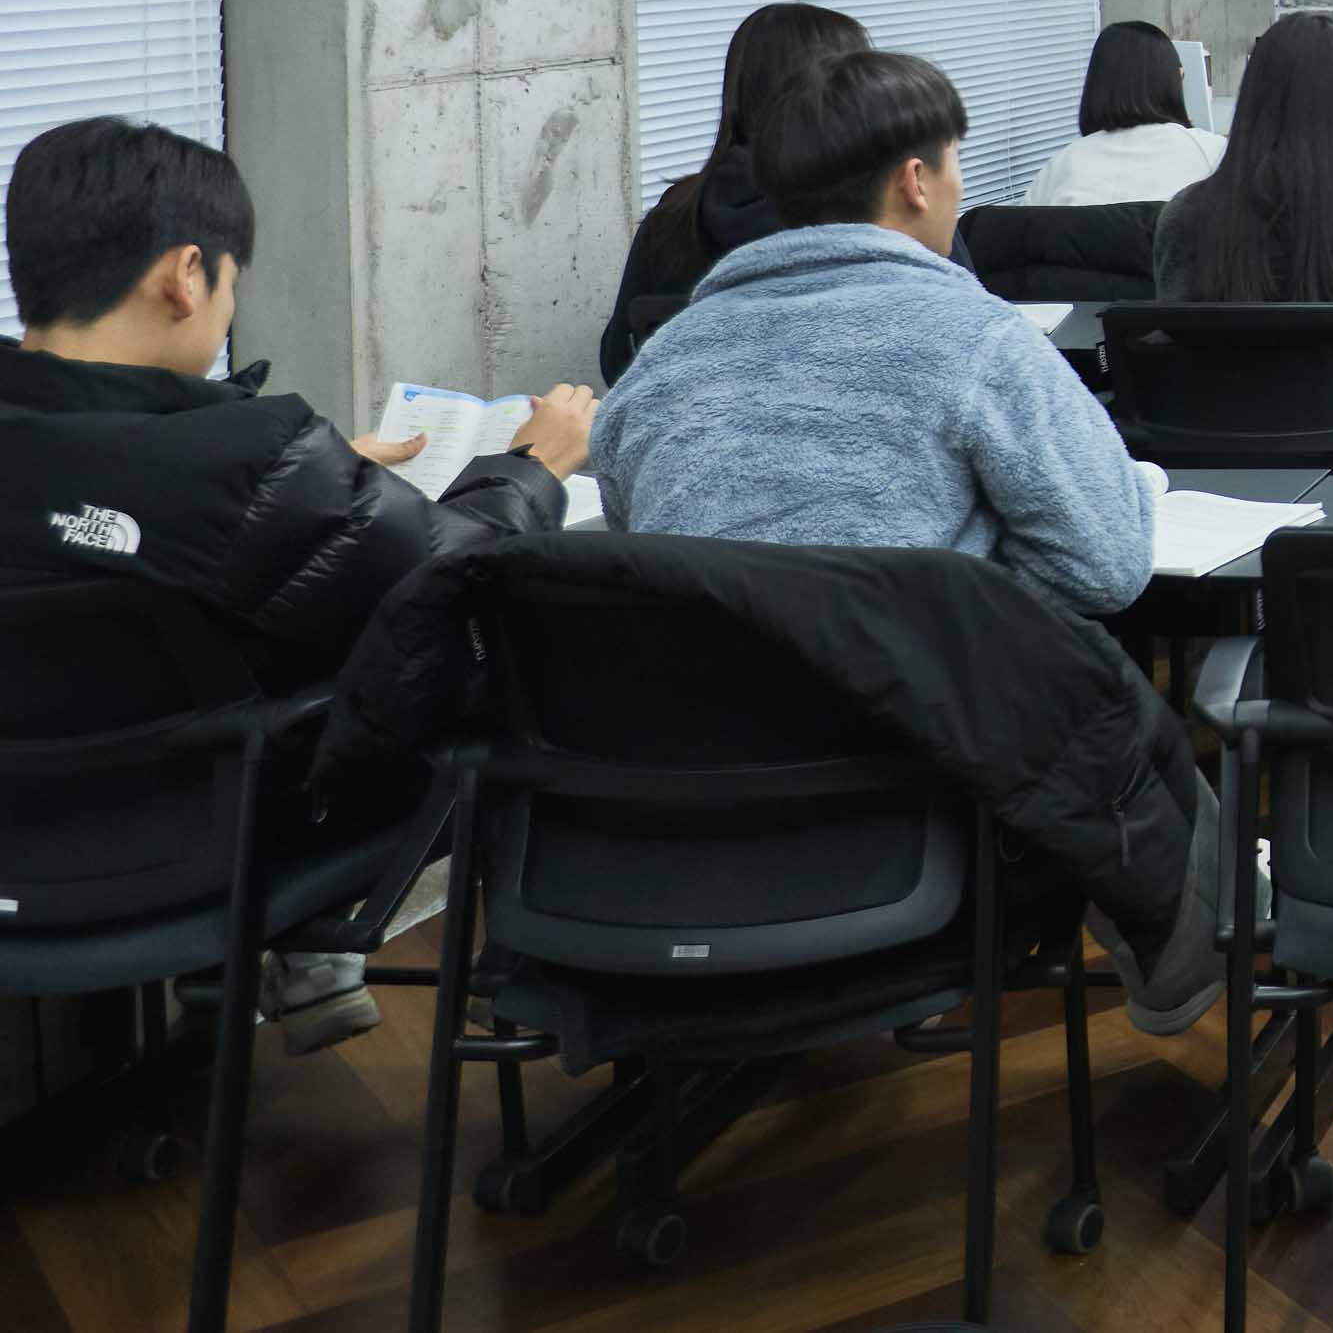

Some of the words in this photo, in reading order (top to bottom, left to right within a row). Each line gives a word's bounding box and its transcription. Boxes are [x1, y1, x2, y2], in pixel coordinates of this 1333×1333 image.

[82, 505, 116, 523] THE
[50, 513, 113, 536] NORTH
[63, 528, 108, 548] FACE
